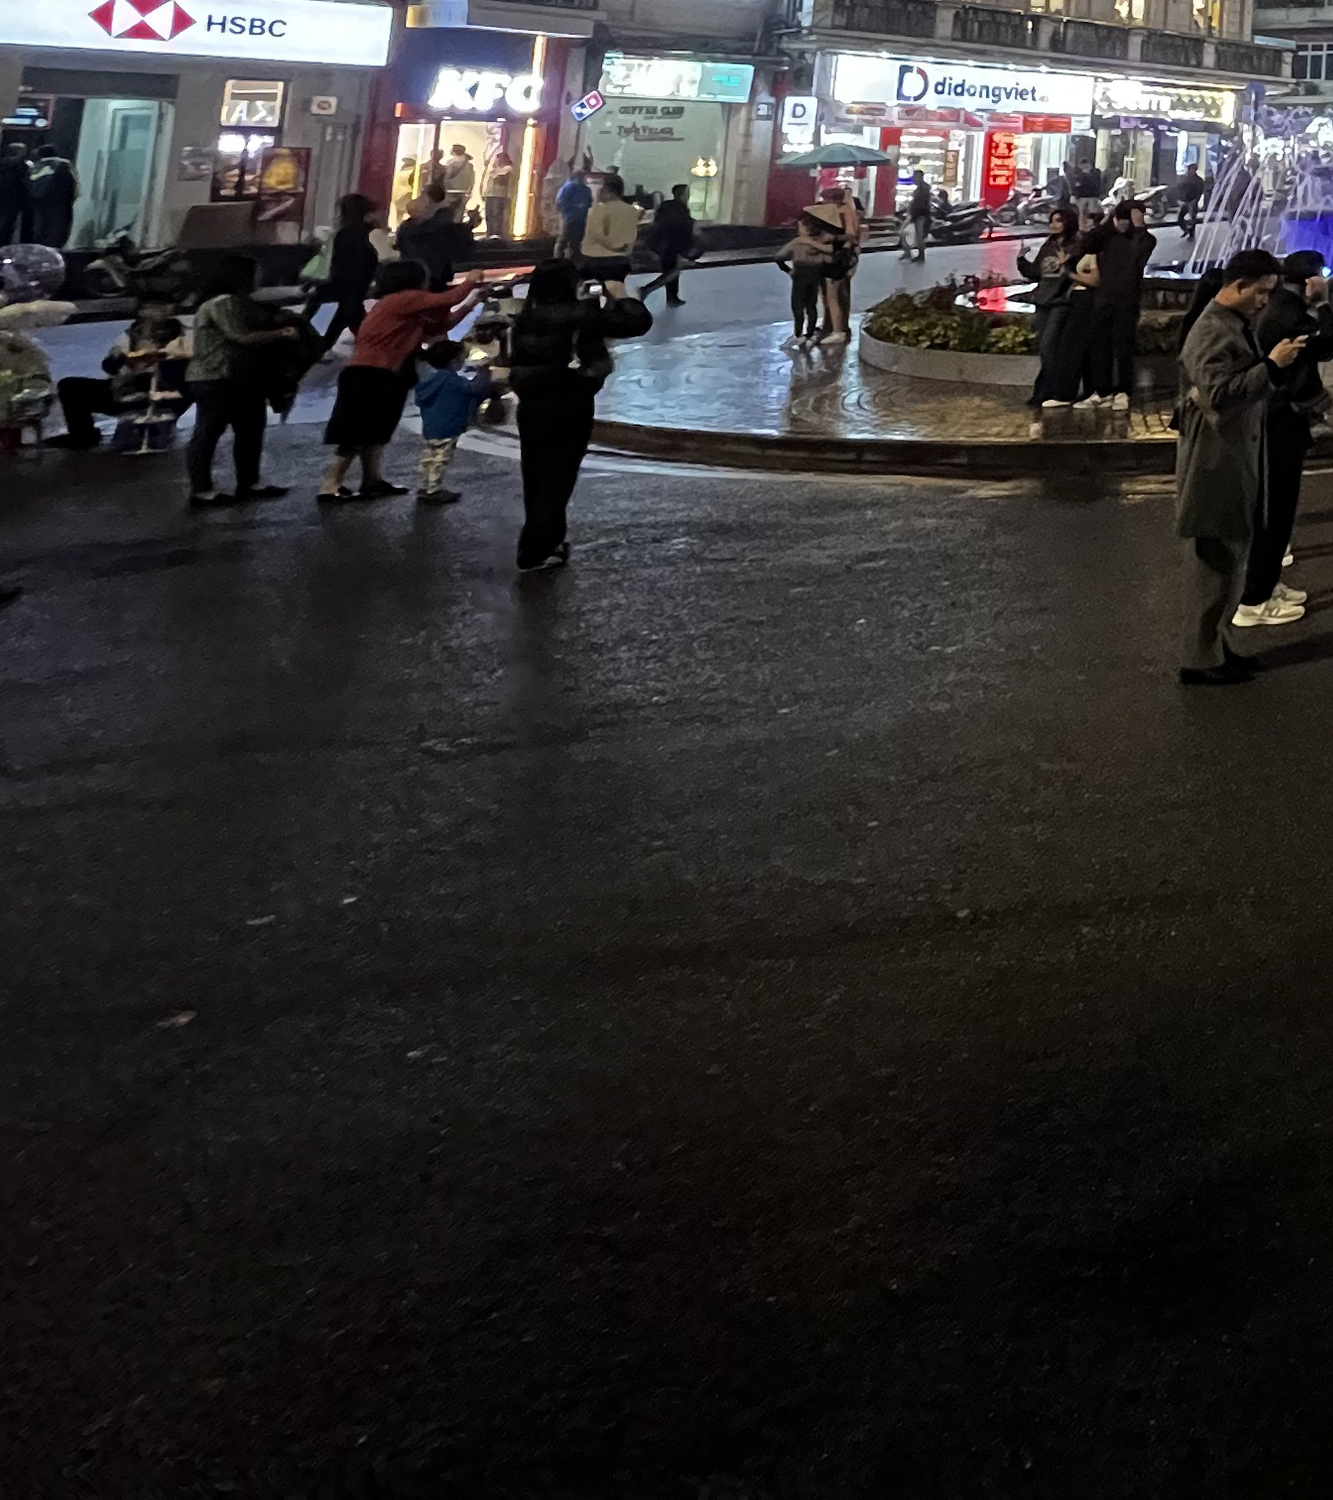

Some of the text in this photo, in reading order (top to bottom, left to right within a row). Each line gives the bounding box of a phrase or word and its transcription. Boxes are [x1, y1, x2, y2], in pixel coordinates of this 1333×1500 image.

[206, 13, 288, 39] HSBC
[427, 69, 545, 114] KFC
[933, 76, 1038, 104] didongviet
